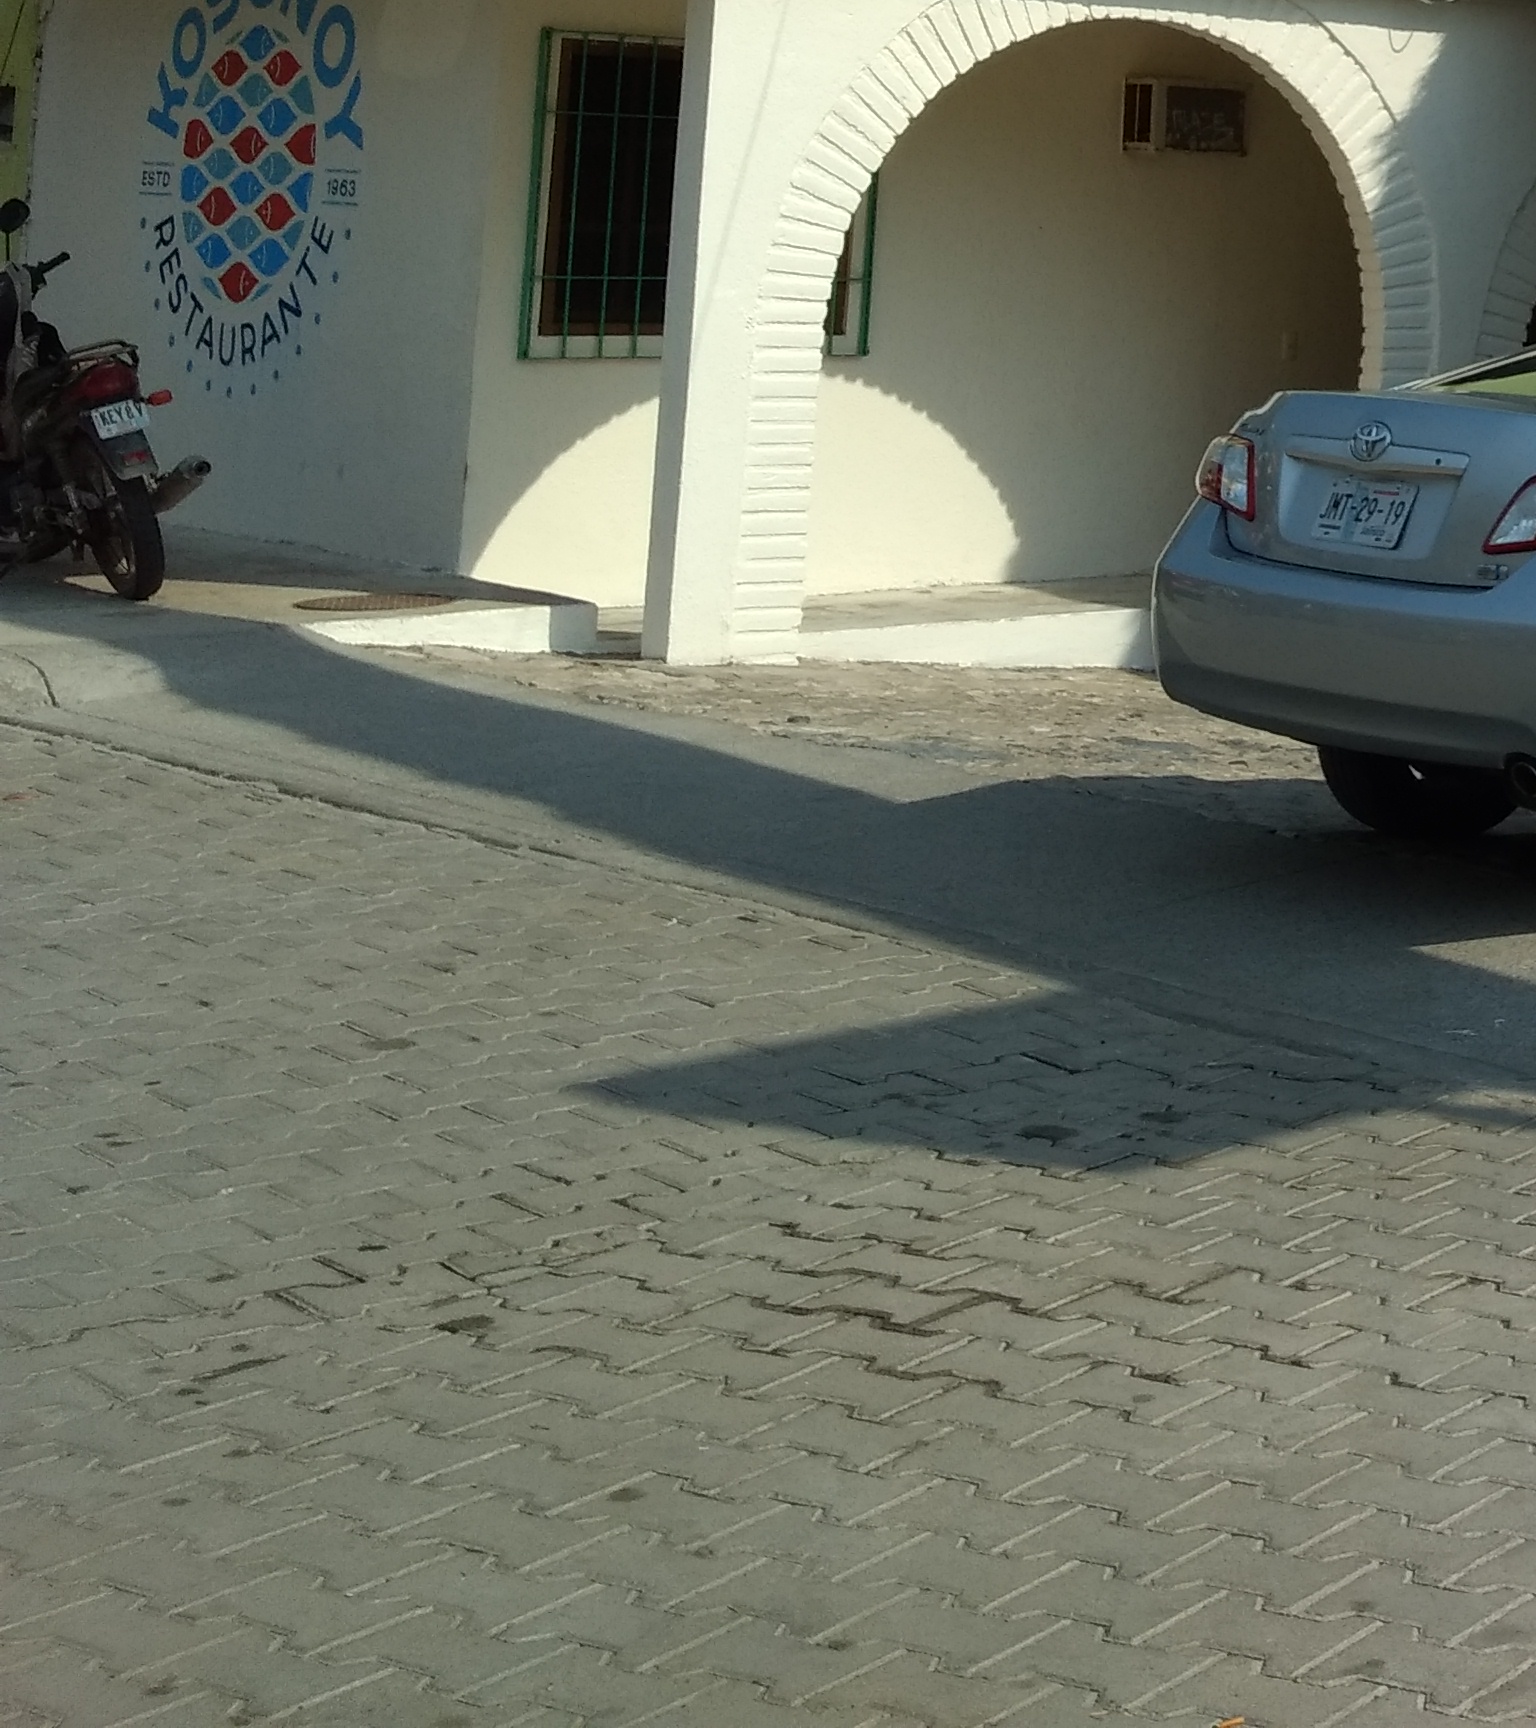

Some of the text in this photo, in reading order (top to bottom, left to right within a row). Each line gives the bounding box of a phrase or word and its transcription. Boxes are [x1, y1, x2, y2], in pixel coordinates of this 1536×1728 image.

[140, 170, 171, 188] ESTD
[326, 177, 357, 198] 1963
[153, 214, 335, 367] RESTAURANTE
